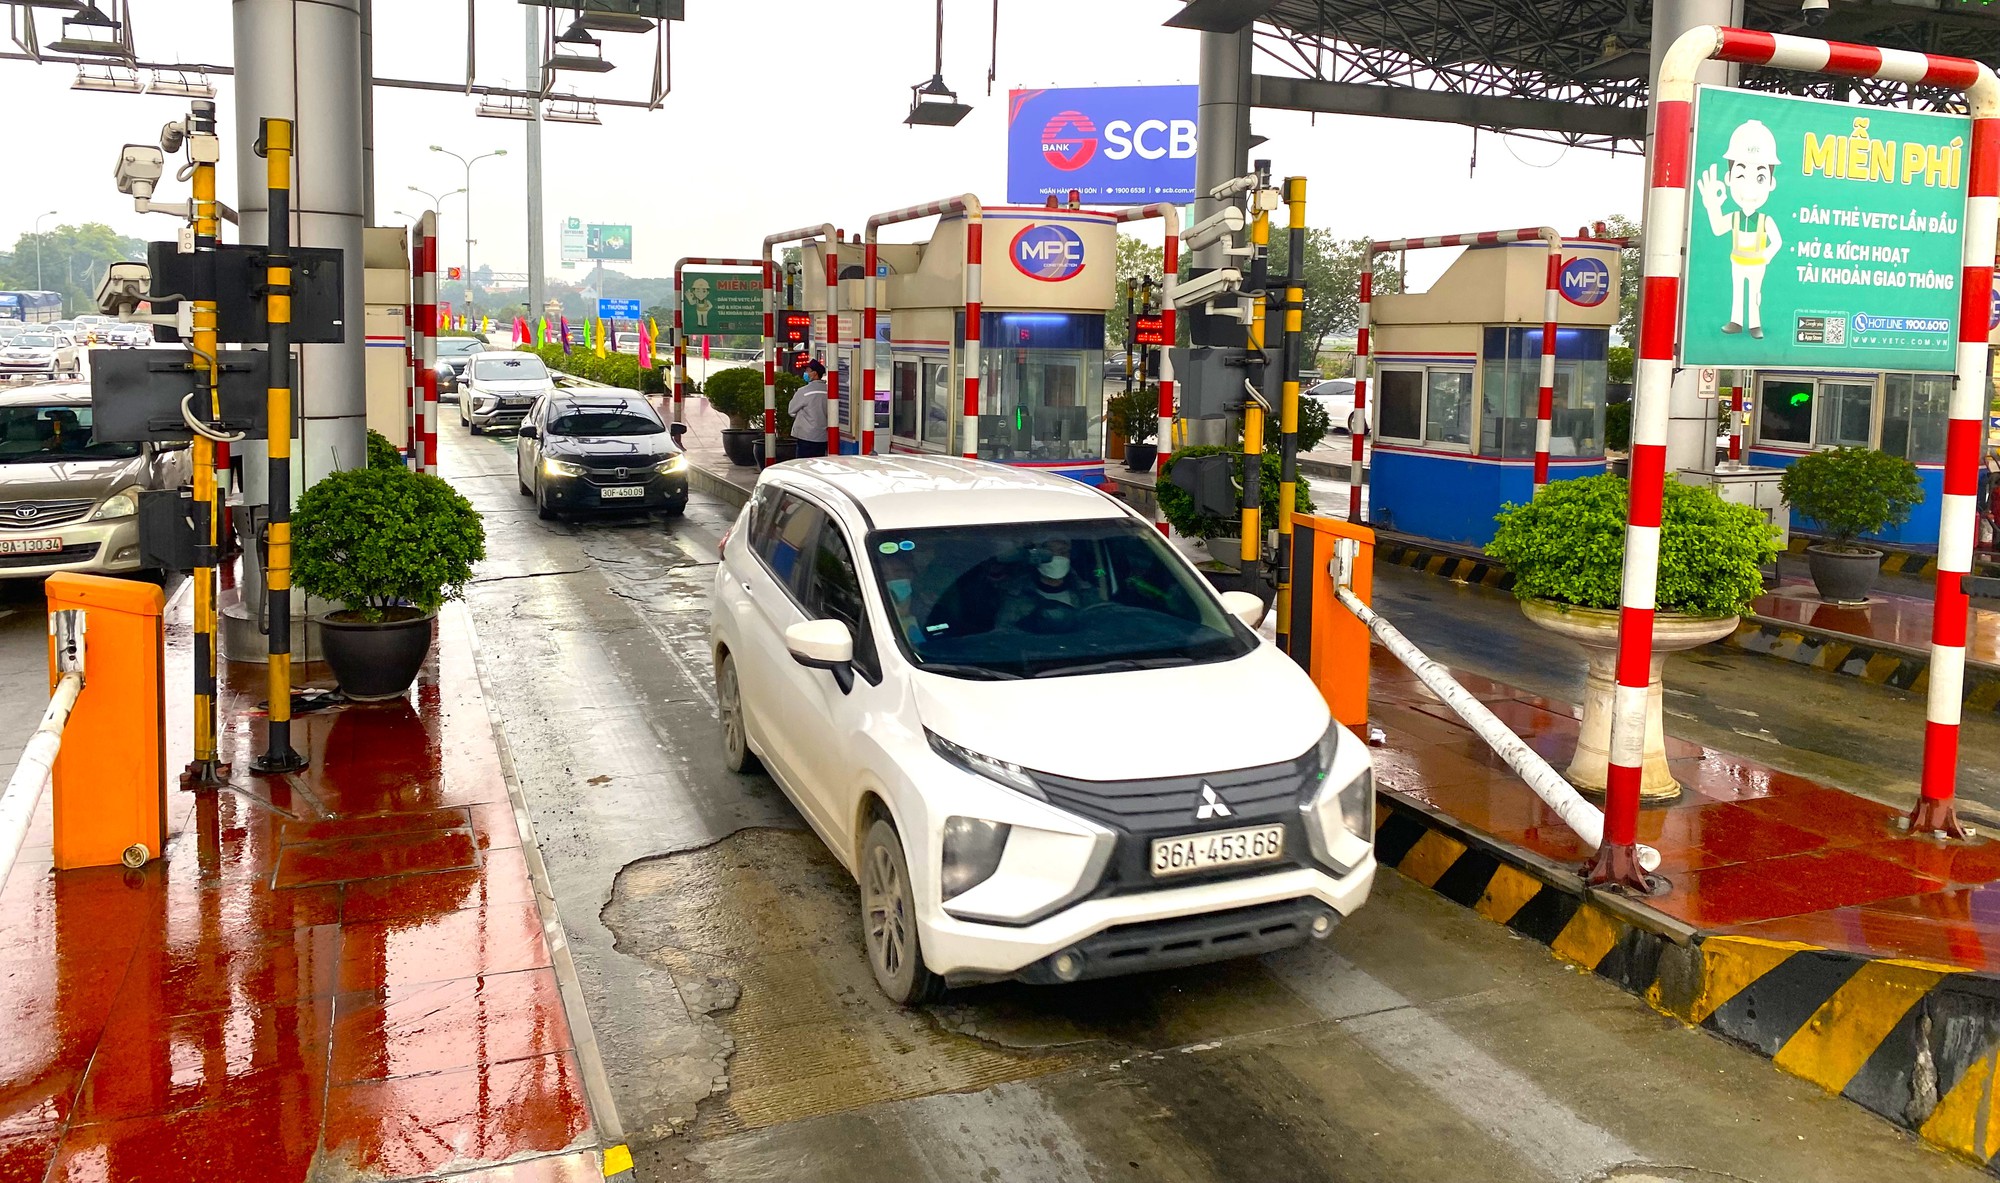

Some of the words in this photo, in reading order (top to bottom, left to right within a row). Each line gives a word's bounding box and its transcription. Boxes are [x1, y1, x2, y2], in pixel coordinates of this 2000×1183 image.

[1042, 143, 1070, 152] BANK
[1103, 119, 1198, 160] SCB
[1803, 117, 1897, 183] MIỄN
[1901, 136, 1964, 190] PHÍ
[1800, 204, 1830, 225] DÁN
[1832, 206, 1860, 228] THẺ
[1862, 212, 1898, 230] VETC
[1900, 208, 1927, 232] LẦN
[1929, 211, 1957, 235] ĐẦU
[1021, 241, 1080, 260] MPC
[1797, 236, 1822, 258] MỞ
[1823, 242, 1834, 259] &
[1836, 240, 1870, 261] KÍCH
[1872, 246, 1910, 268] HOẠT
[750, 280, 763, 291] PH
[1565, 271, 1607, 288] MPC
[1796, 262, 1819, 283] TÀI
[1821, 264, 1871, 286] KHOẢN
[1873, 270, 1906, 288] GIAO
[1908, 269, 1954, 290] THÔNG
[1905, 319, 1948, 331] 1900.6010
[0, 540, 59, 552] 9A-130.34
[1157, 831, 1279, 869] 36A-453.68
